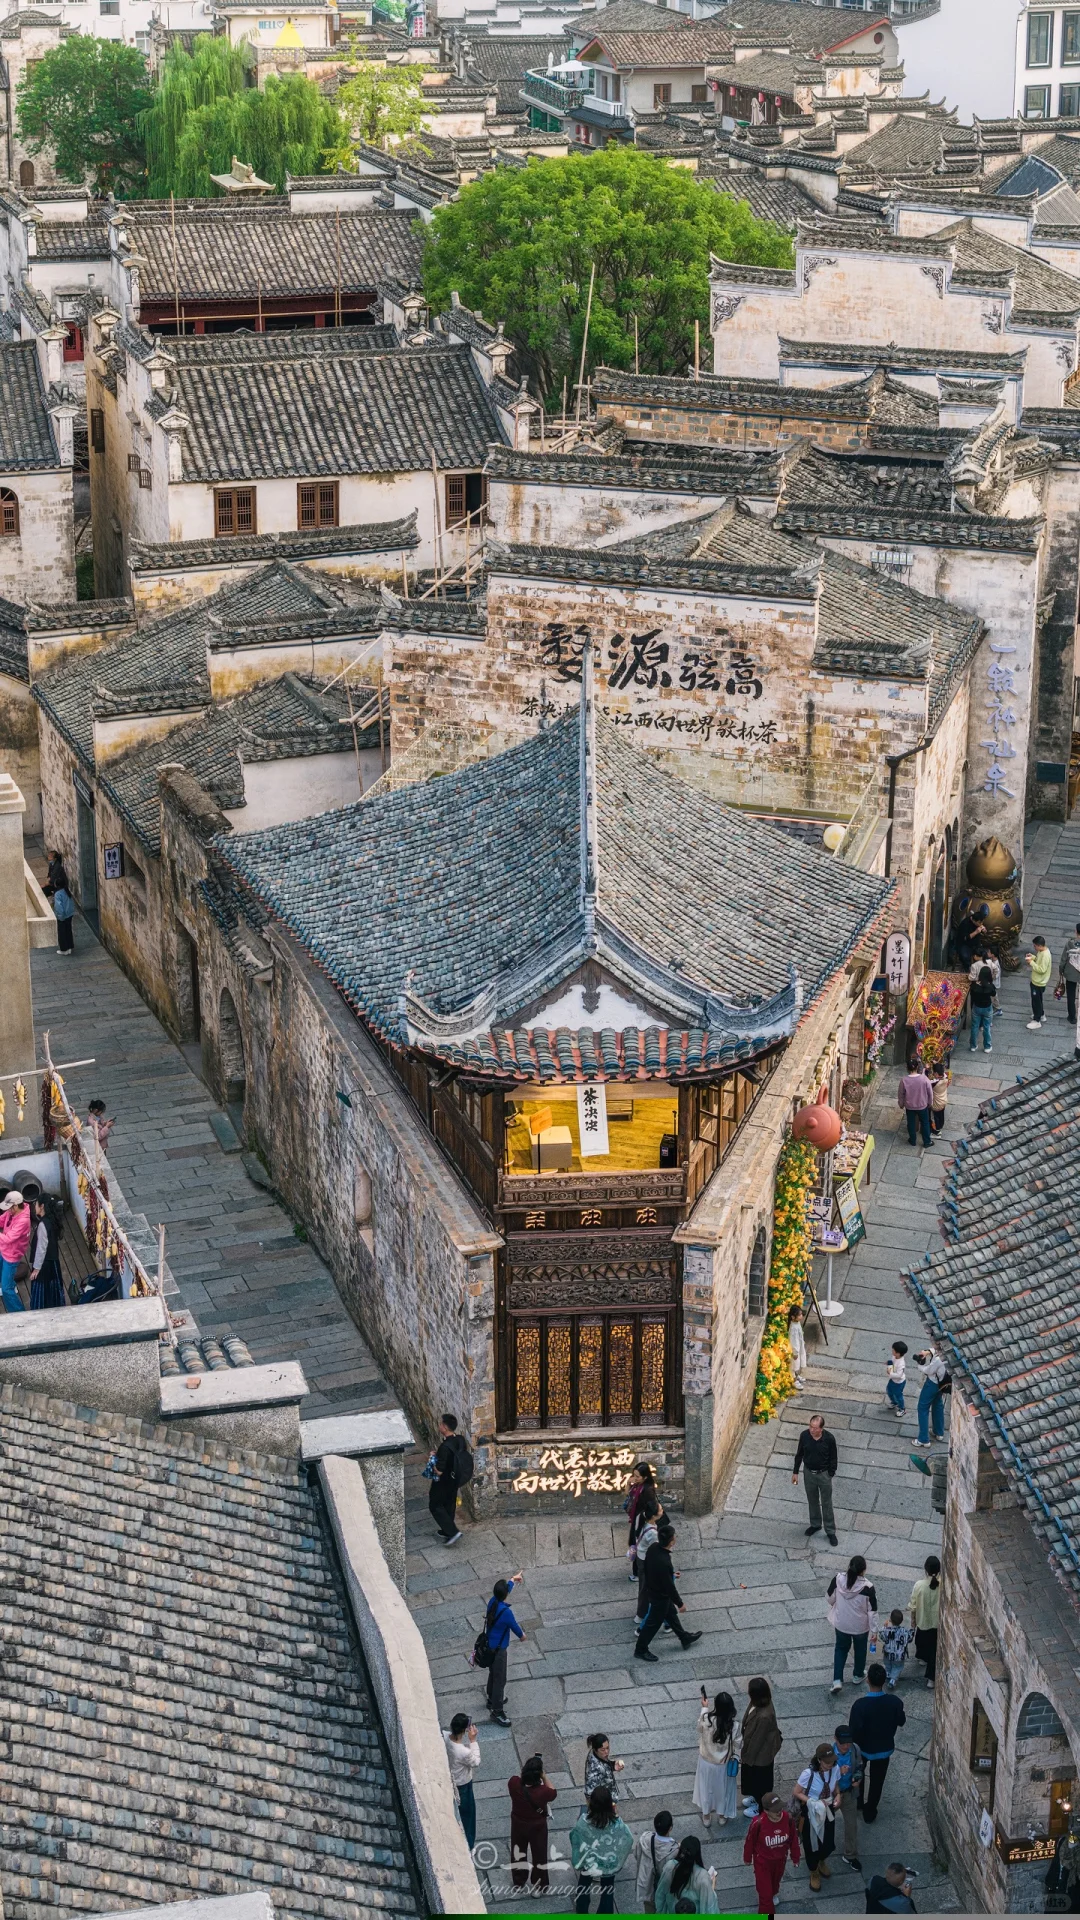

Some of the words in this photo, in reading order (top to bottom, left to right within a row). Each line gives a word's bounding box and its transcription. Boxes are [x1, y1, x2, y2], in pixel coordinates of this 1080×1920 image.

[603, 705, 778, 744] 江西向世界敬杯茶
[539, 1447, 635, 1471] 代表江西
[512, 1465, 658, 1498] 向世界敬杯
